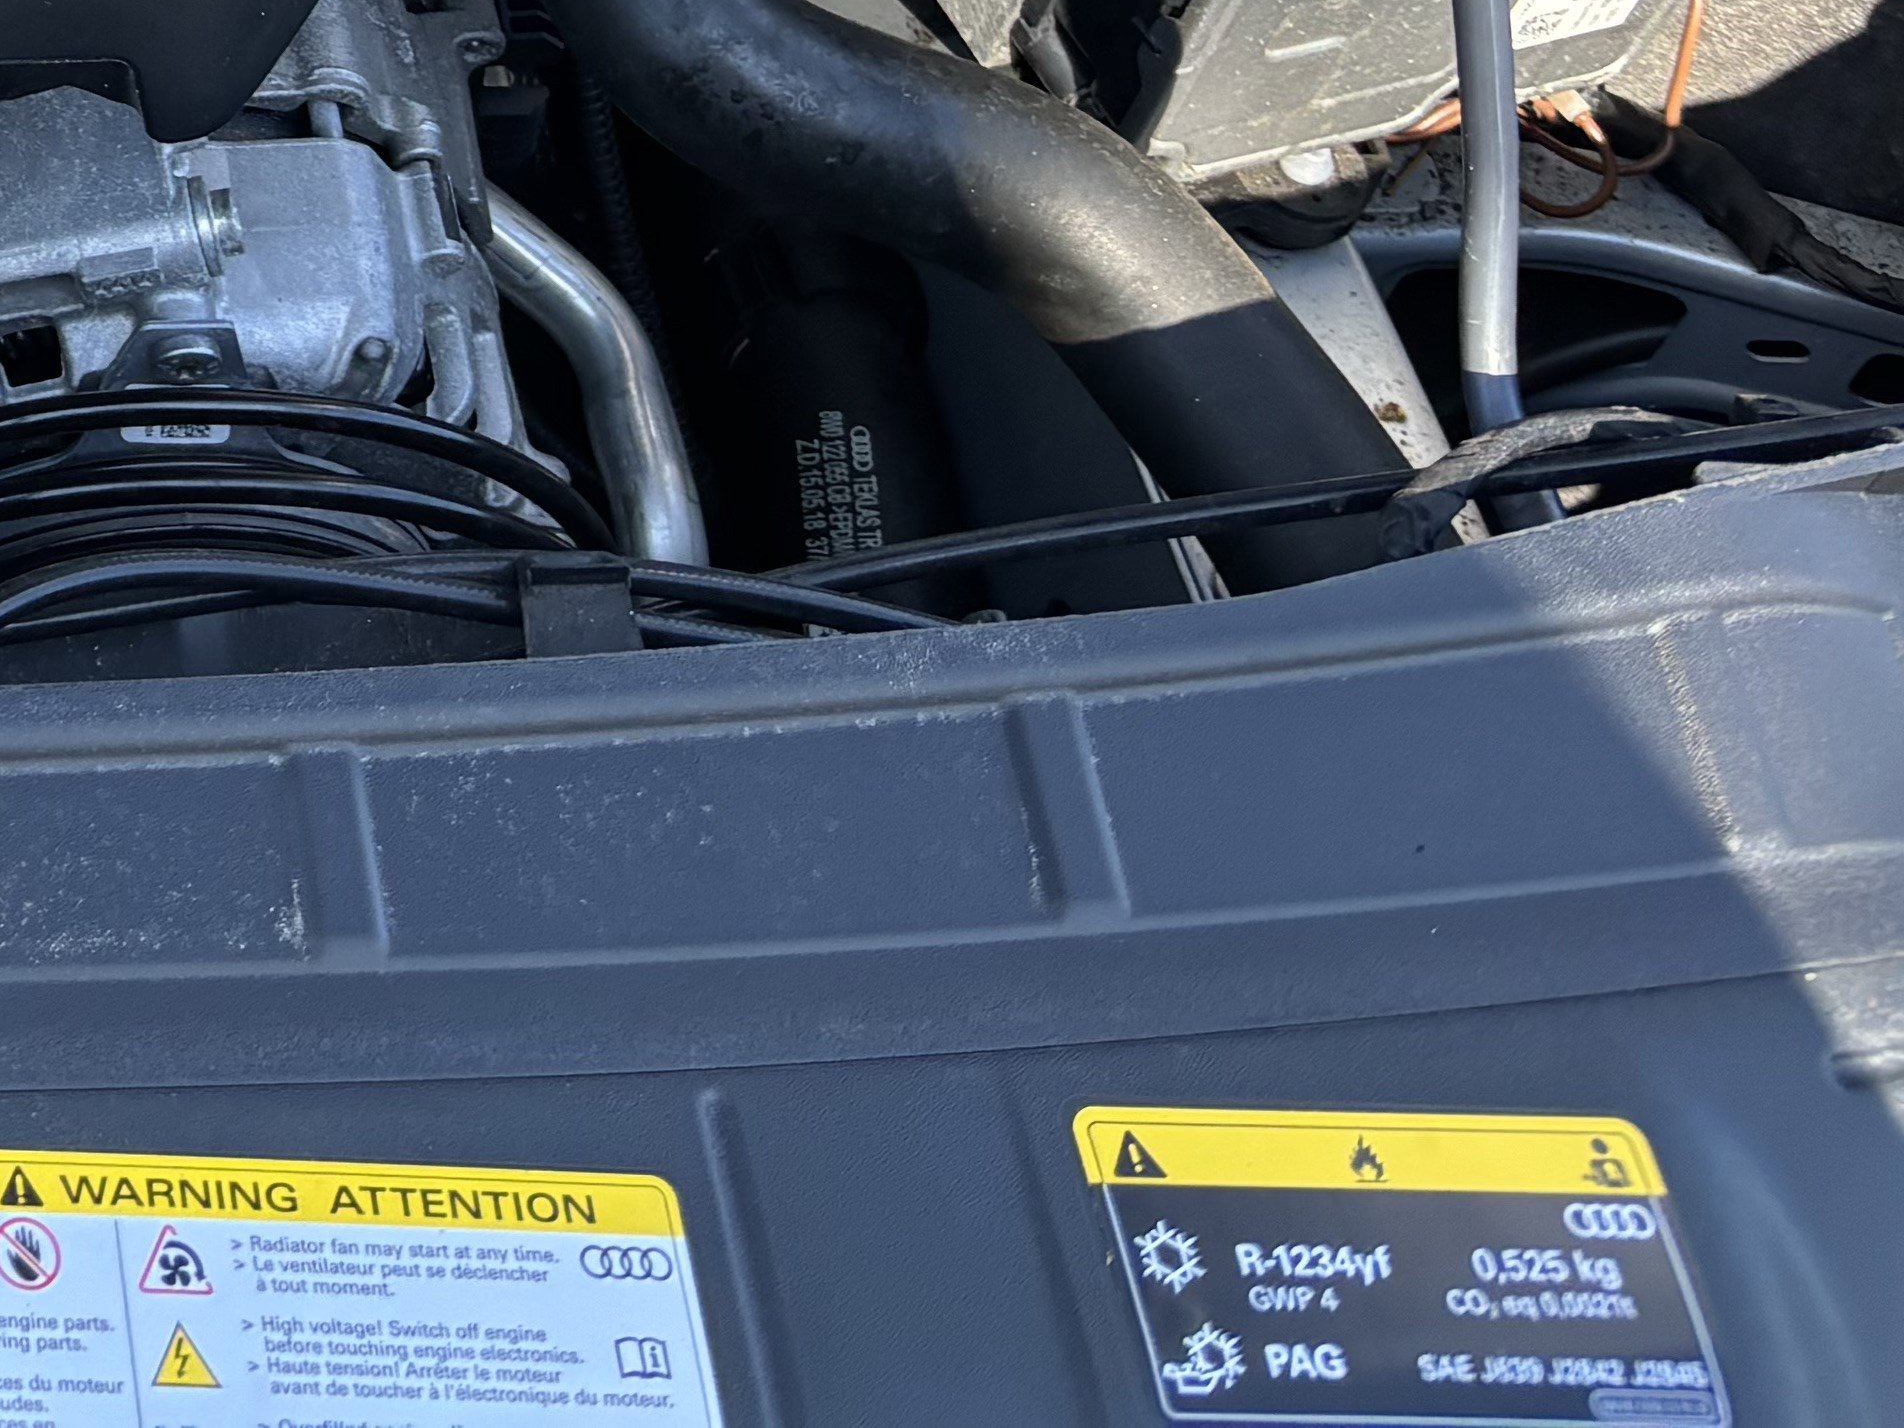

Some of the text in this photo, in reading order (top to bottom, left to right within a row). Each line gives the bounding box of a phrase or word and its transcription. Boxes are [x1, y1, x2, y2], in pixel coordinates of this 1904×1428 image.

[853, 474, 882, 548] TEKLAS TR
[57, 1174, 599, 1225] WARNING ATTENTION
[250, 1235, 561, 1264] Radiator fan may start at any time.
[1235, 1242, 1393, 1286] R-1234yf
[253, 1256, 549, 1281] Le ventilateur peut se déclencher
[1471, 1246, 1623, 1291] 0,525 kg
[271, 1279, 308, 1293] tout
[313, 1280, 395, 1297] moment.
[1248, 1284, 1341, 1313] GWP 4
[64, 1317, 115, 1332] parts.
[261, 1316, 547, 1343] High voltage! Switch off engine
[36, 1336, 87, 1353] parts.
[264, 1336, 584, 1364] before touching engine electronics.
[267, 1356, 320, 1374] Haute
[326, 1359, 400, 1378] tension!
[474, 1365, 492, 1381] le
[496, 1367, 561, 1383] moteur
[1264, 1343, 1350, 1380] PAG
[1417, 1353, 1477, 1383] SAE
[29, 1375, 52, 1391] du
[58, 1380, 124, 1393] moteur
[270, 1380, 320, 1395] avant
[326, 1380, 349, 1396] de
[354, 1383, 425, 1398] toucher
[574, 1388, 597, 1405] du
[603, 1392, 674, 1409] moteur.
